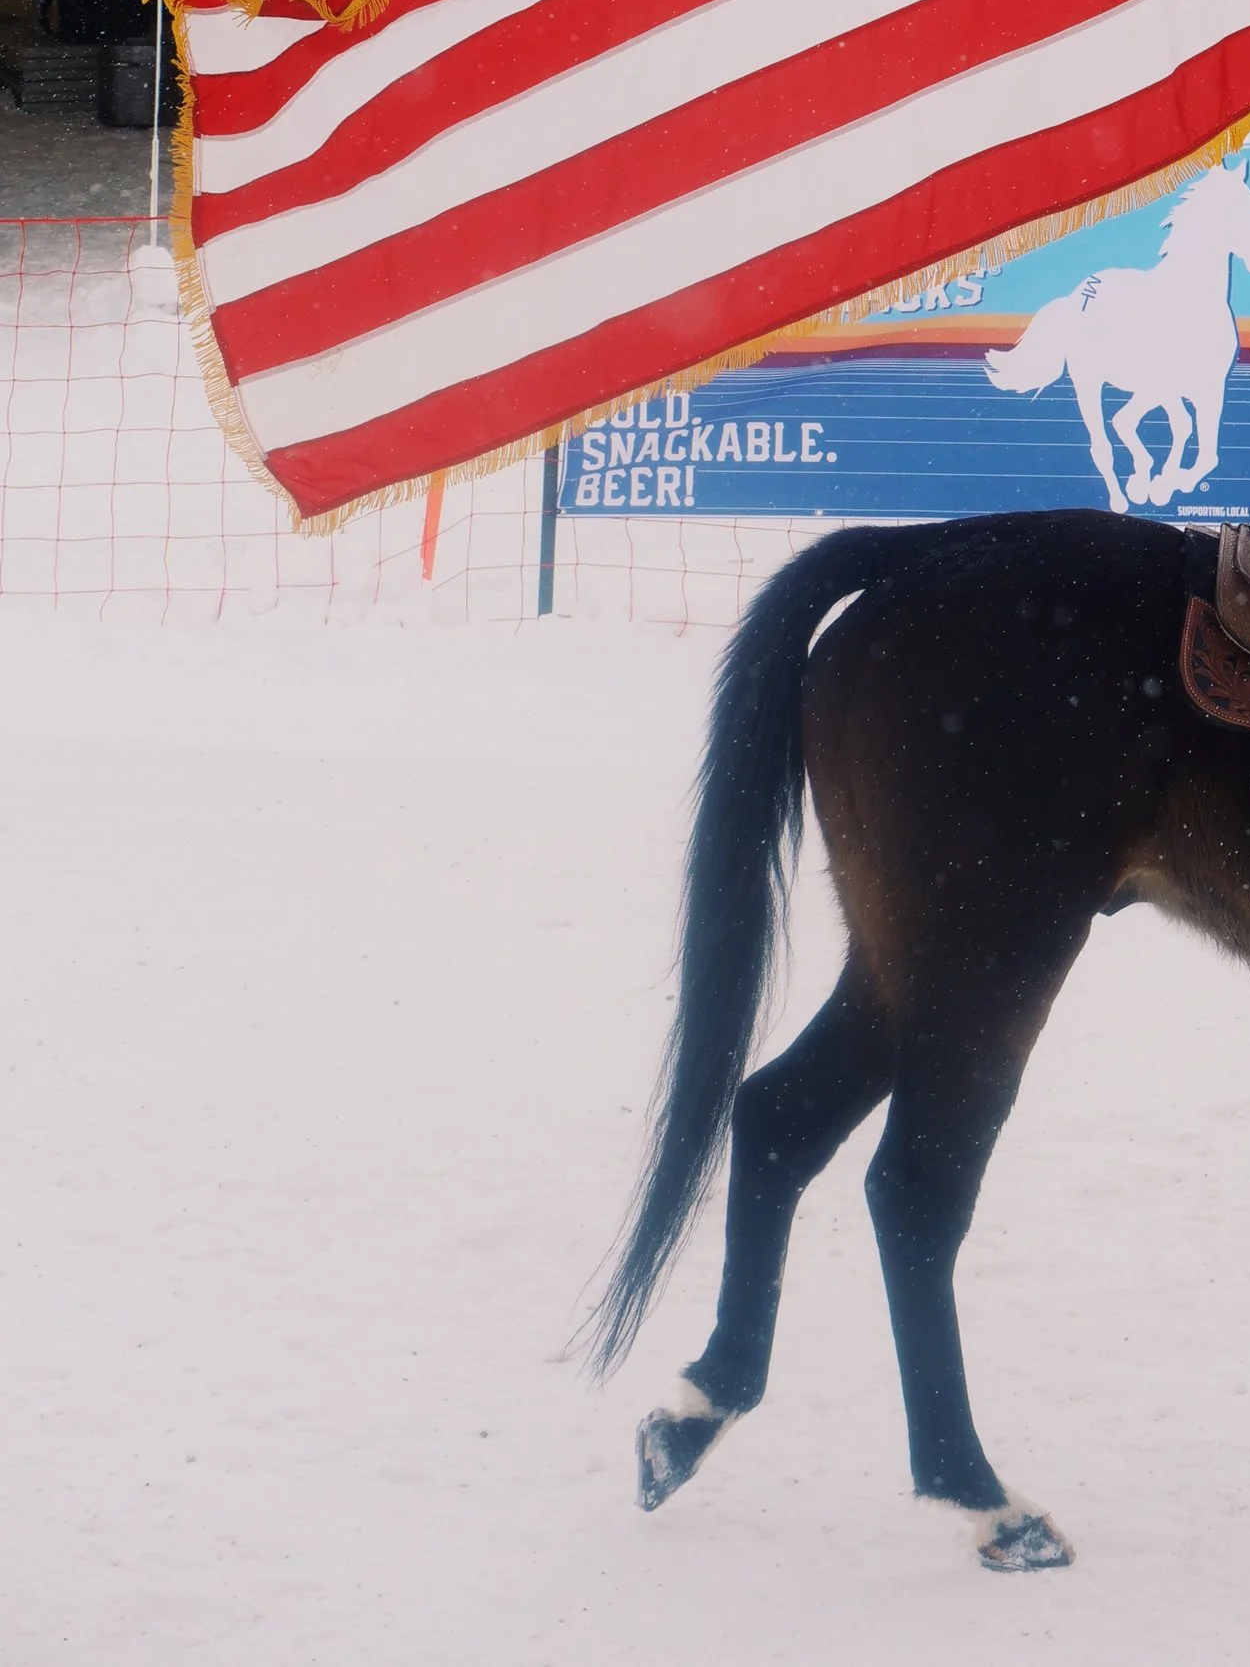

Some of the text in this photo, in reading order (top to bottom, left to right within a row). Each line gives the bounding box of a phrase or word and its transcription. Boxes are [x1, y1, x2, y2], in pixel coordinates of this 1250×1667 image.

[589, 392, 702, 429] OLD.
[582, 421, 838, 471] SNACKABLE.
[574, 465, 696, 507] BEER!
[1177, 506, 1226, 517] SUPPORTING
[1227, 506, 1249, 517] LOCAL
